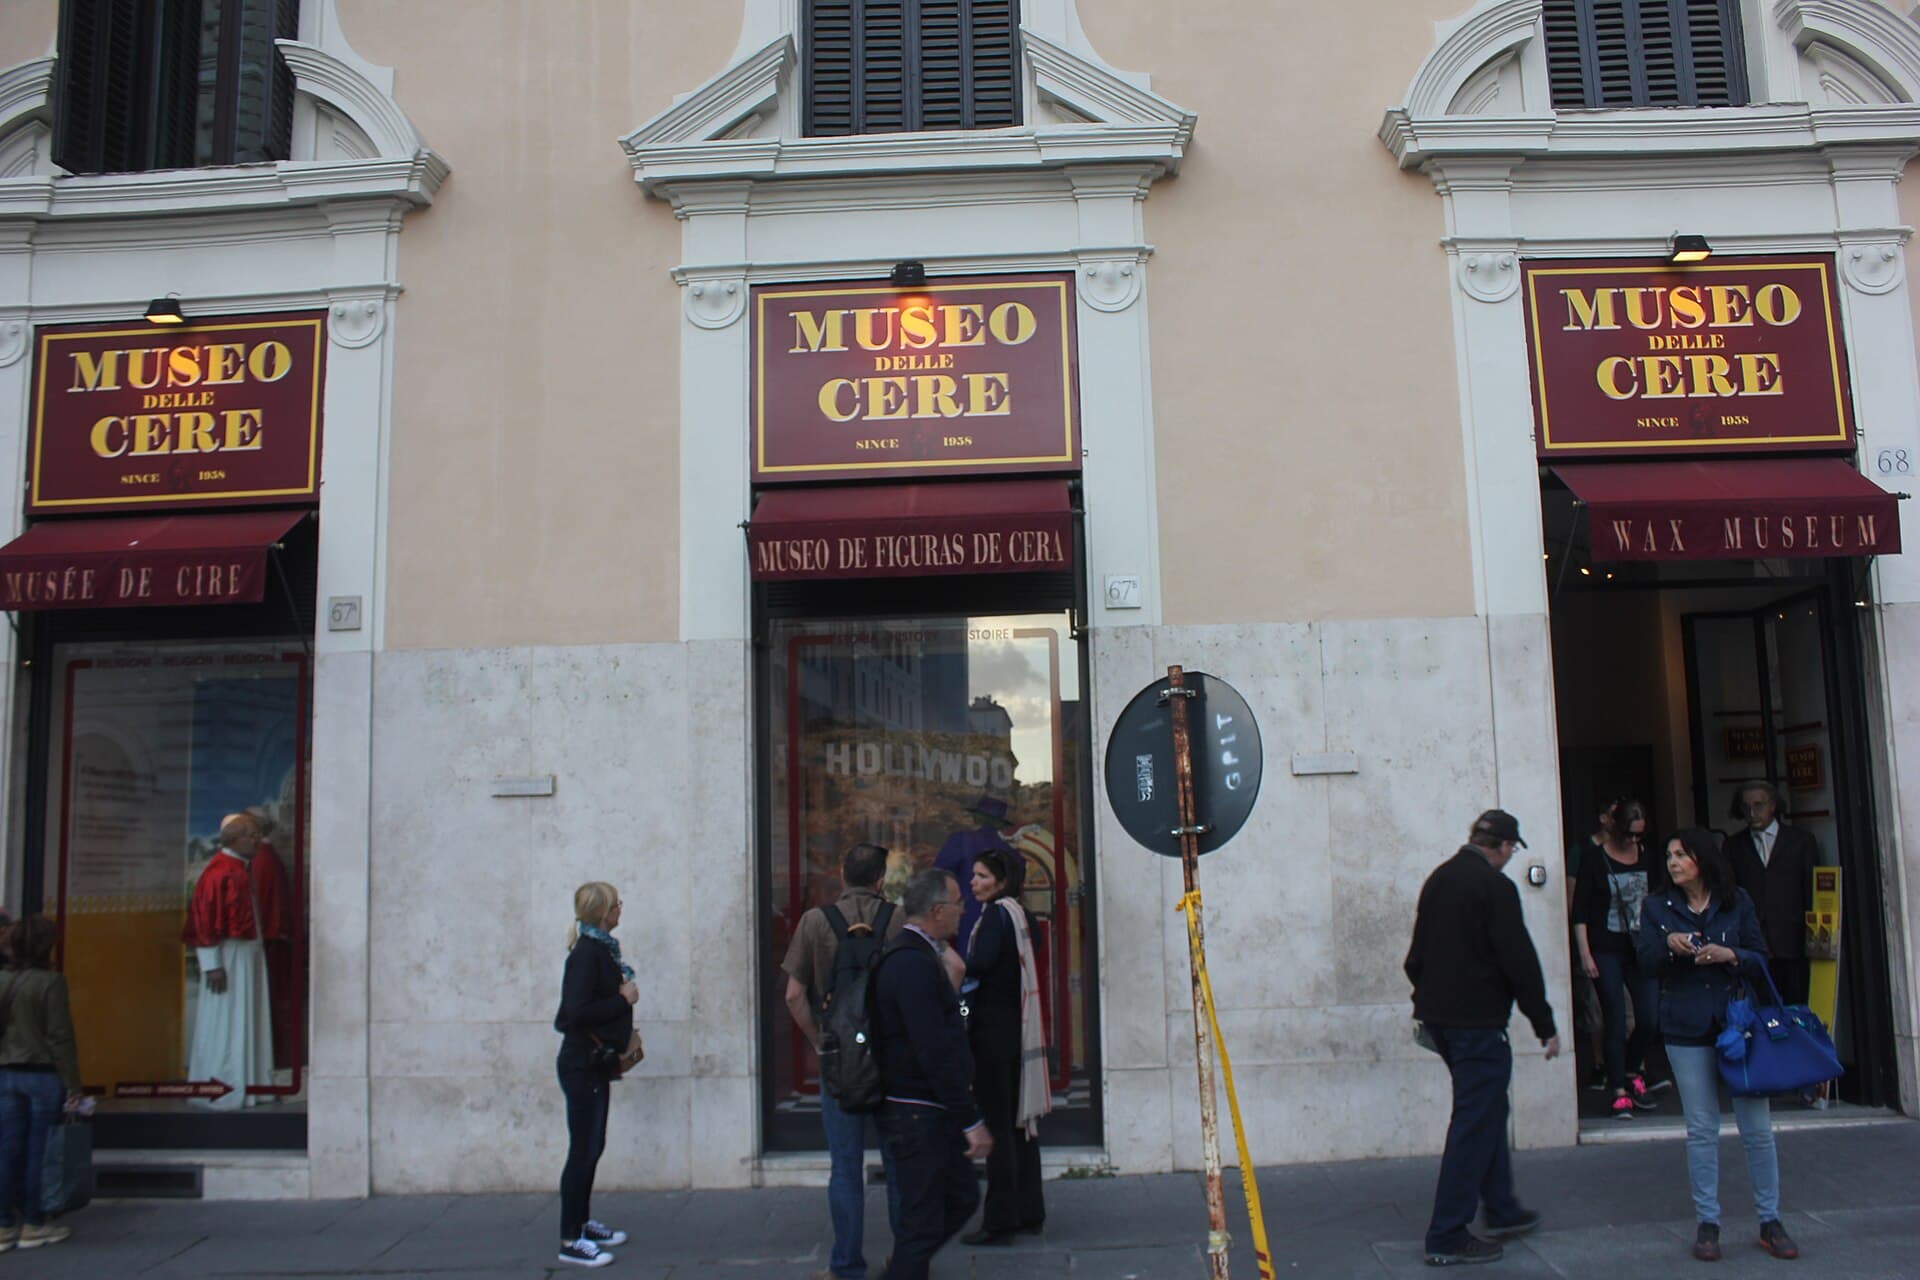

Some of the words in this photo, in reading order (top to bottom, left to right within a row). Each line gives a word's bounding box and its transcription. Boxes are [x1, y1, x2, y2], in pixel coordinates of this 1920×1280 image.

[1559, 283, 1802, 331] MUSEO
[788, 302, 1037, 354] MUSEO
[1648, 334, 1725, 350] DELLE
[67, 341, 292, 392] MUSEO
[874, 354, 954, 371] DELLE
[1596, 353, 1784, 400] CERE
[143, 391, 215, 409] DELLE
[817, 372, 1011, 422] CERE
[90, 408, 263, 458] CERE
[1637, 417, 1679, 428] SINCE
[1721, 415, 1750, 426] 1958
[856, 438, 900, 449] SINCE
[943, 436, 973, 447] 1958
[1878, 449, 1910, 473] 68
[121, 473, 160, 484] SINCE
[199, 470, 226, 481] 1958
[757, 538, 830, 572] MUSEO
[838, 537, 867, 569] DE
[875, 533, 964, 568] FIGURAS
[972, 532, 1002, 565] DE
[1008, 529, 1064, 563] CERA
[1613, 519, 1685, 552] WAX
[1724, 514, 1878, 550] MUSEUM
[6, 566, 95, 603] MUSÉE
[119, 567, 152, 598] DE
[176, 564, 242, 597] CIRE
[825, 742, 1013, 789] HOLLYWOO
